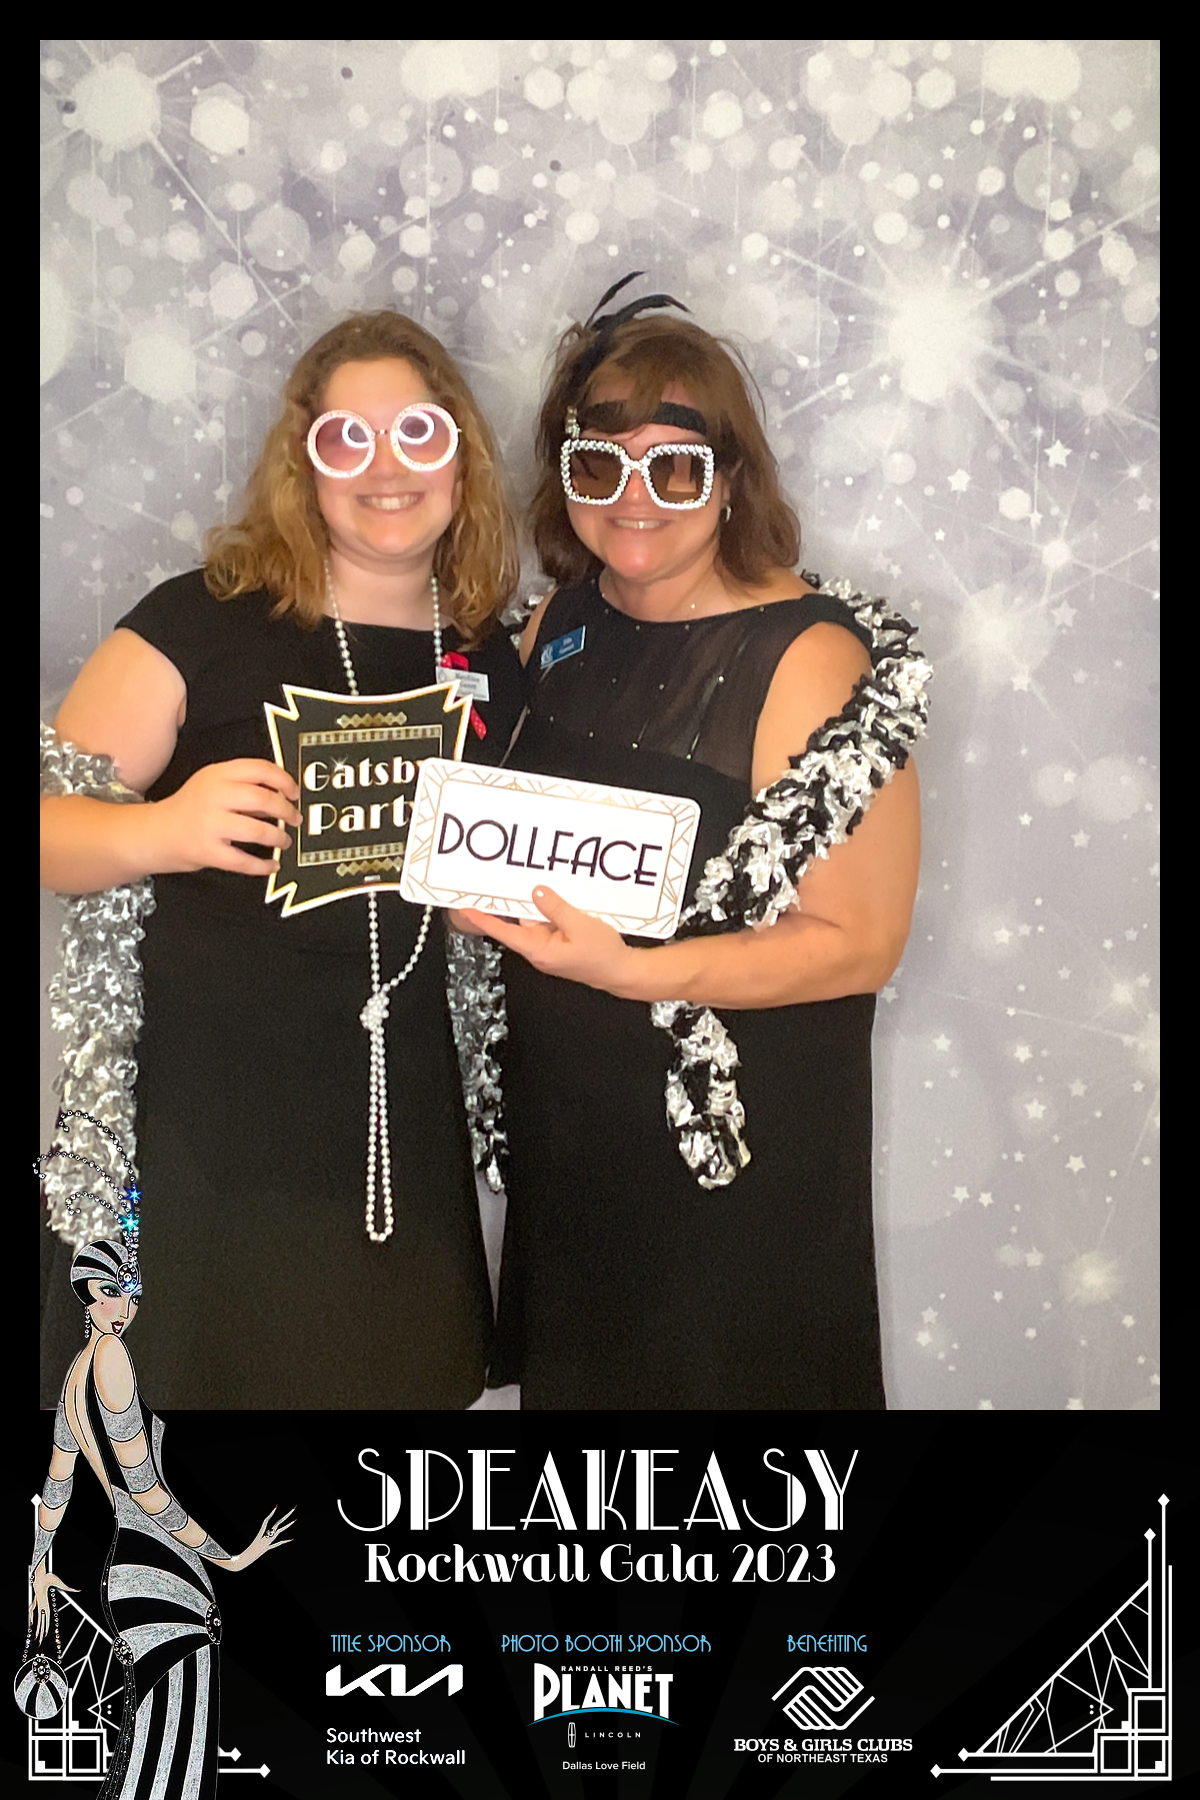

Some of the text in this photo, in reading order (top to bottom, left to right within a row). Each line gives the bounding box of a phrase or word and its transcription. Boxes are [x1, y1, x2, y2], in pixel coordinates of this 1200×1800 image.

[303, 756, 420, 791] Gatsb
[308, 794, 415, 836] Part
[437, 812, 663, 886] DOLLFACE
